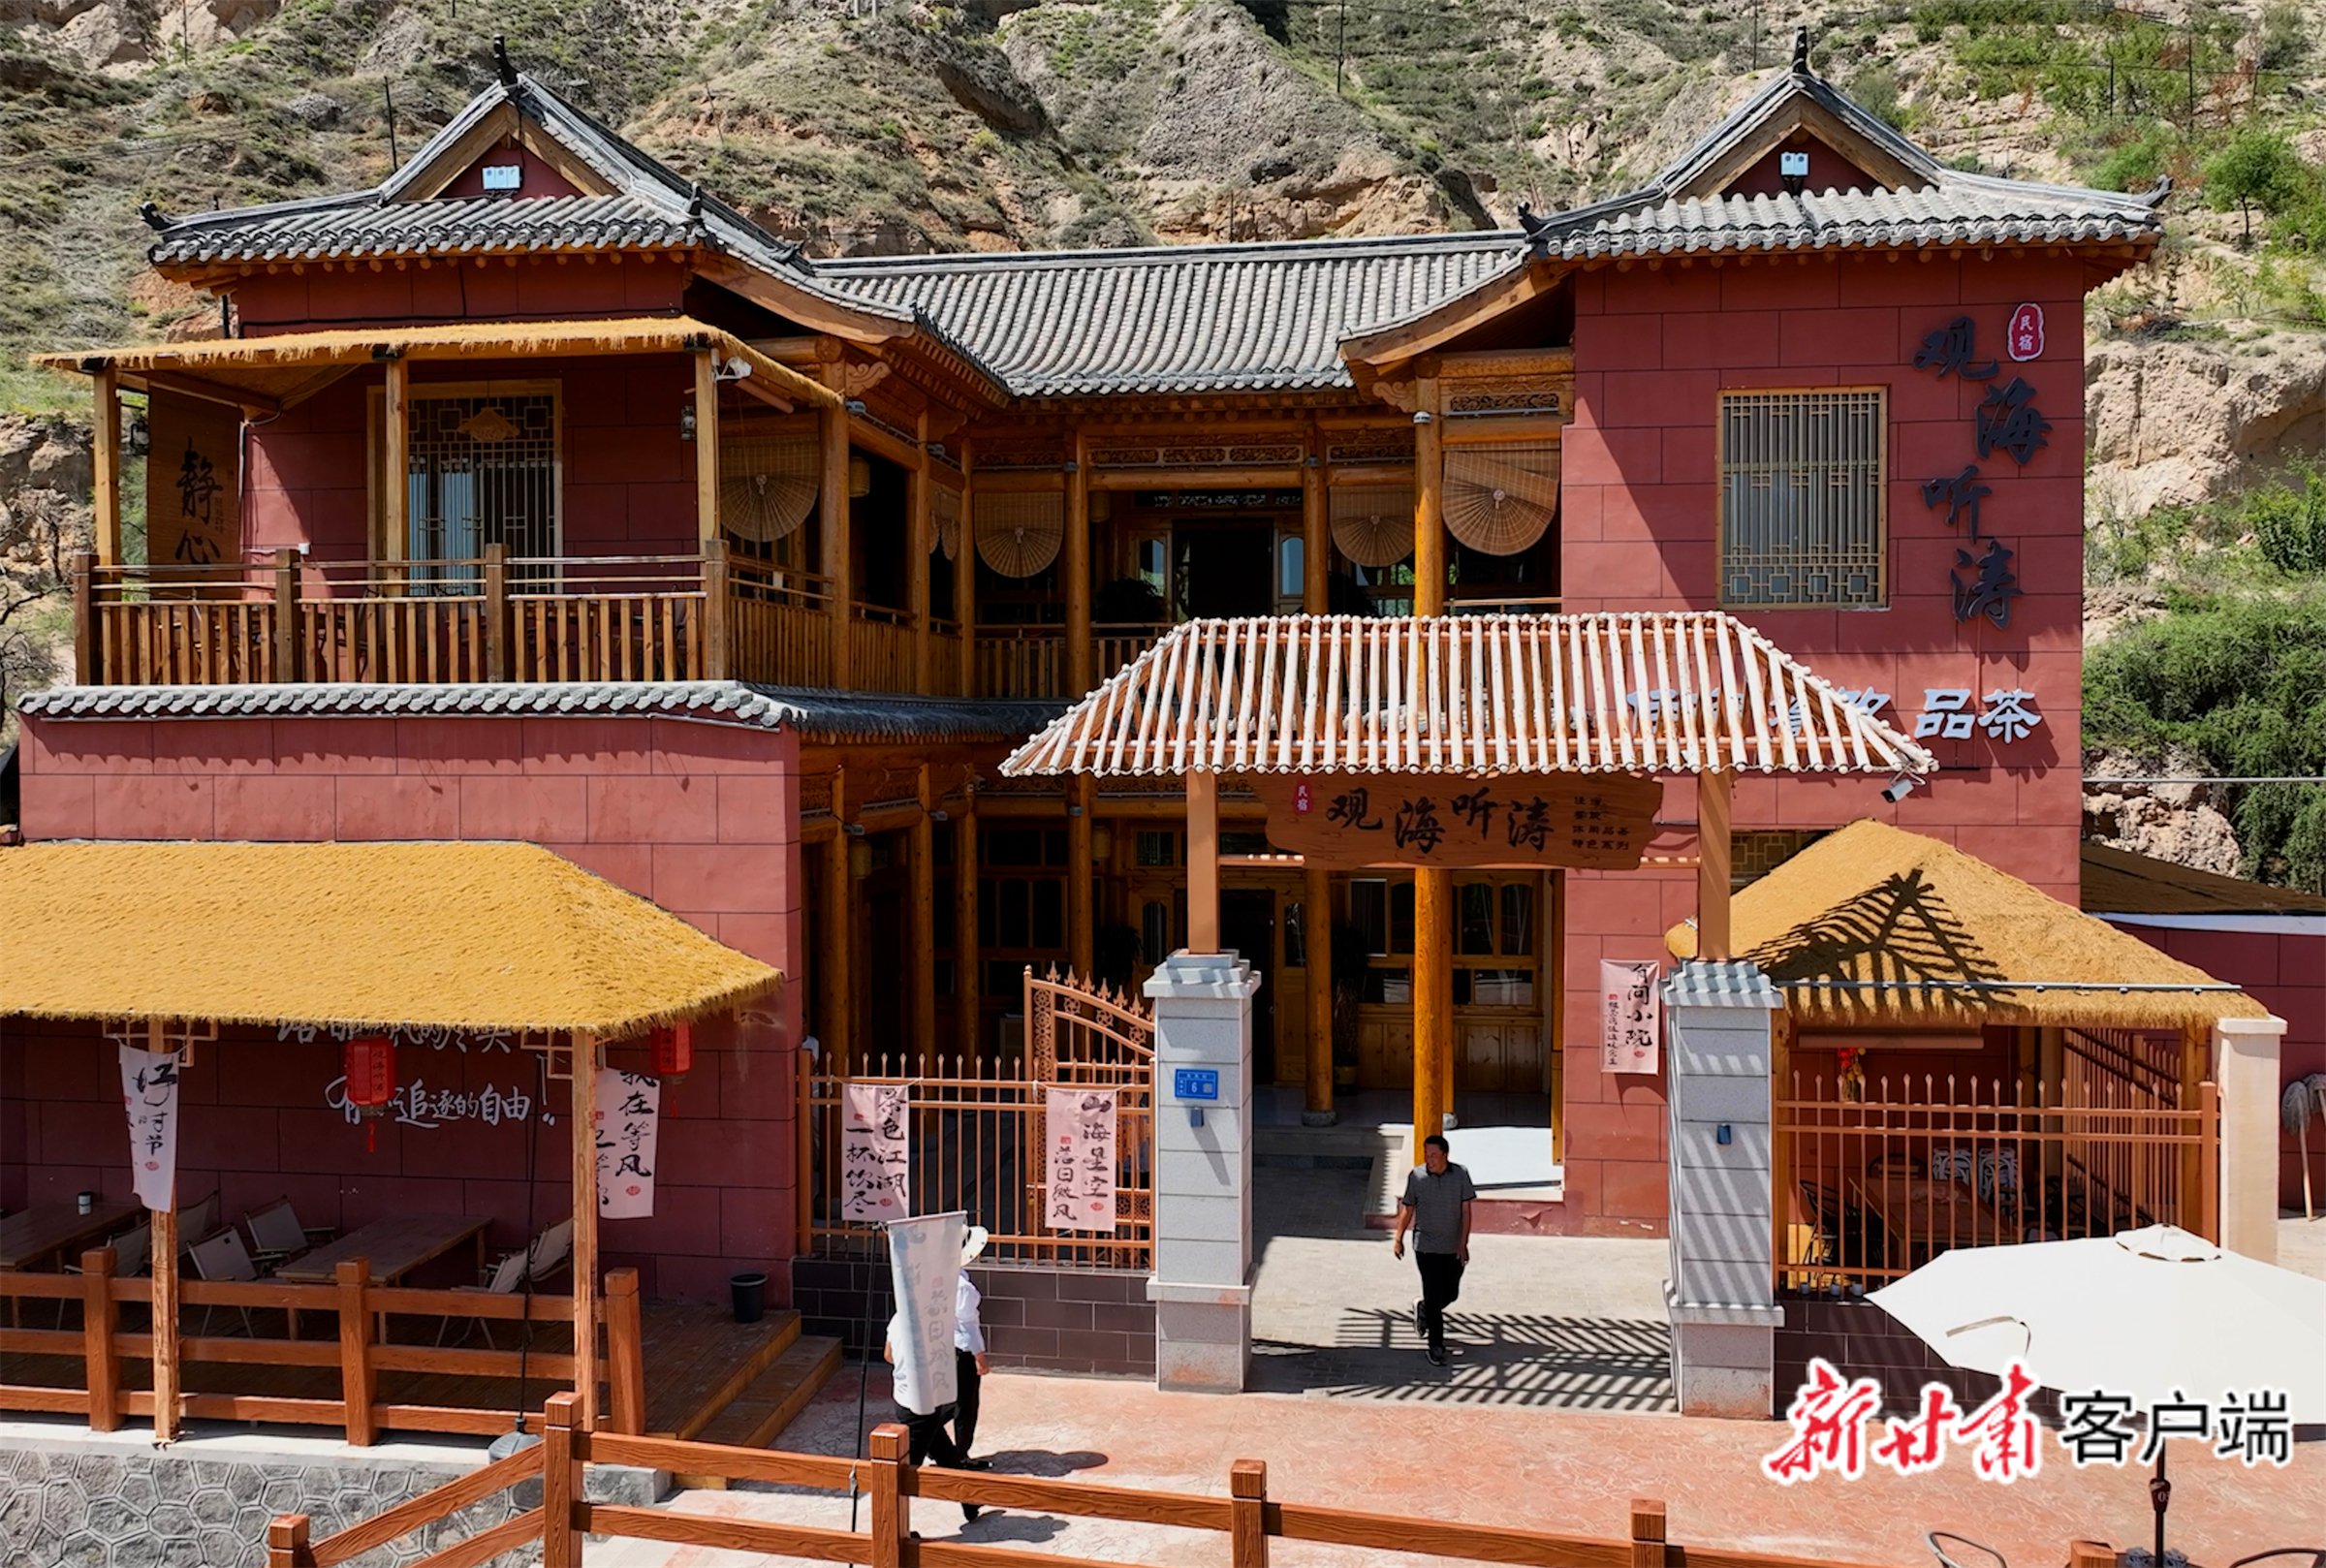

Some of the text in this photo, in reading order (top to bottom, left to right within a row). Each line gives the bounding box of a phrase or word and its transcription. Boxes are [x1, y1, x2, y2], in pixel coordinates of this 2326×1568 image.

[2018, 314, 2035, 352] 民宿
[175, 436, 223, 574] 静心
[1912, 315, 2053, 630] 观海听涛
[1296, 784, 1308, 811] 民宿
[1326, 786, 1555, 855] 观海听涛
[1191, 1081, 1198, 1093] 6
[876, 1088, 908, 1198] 茶色江湖
[1081, 1096, 1112, 1199] 山海星空
